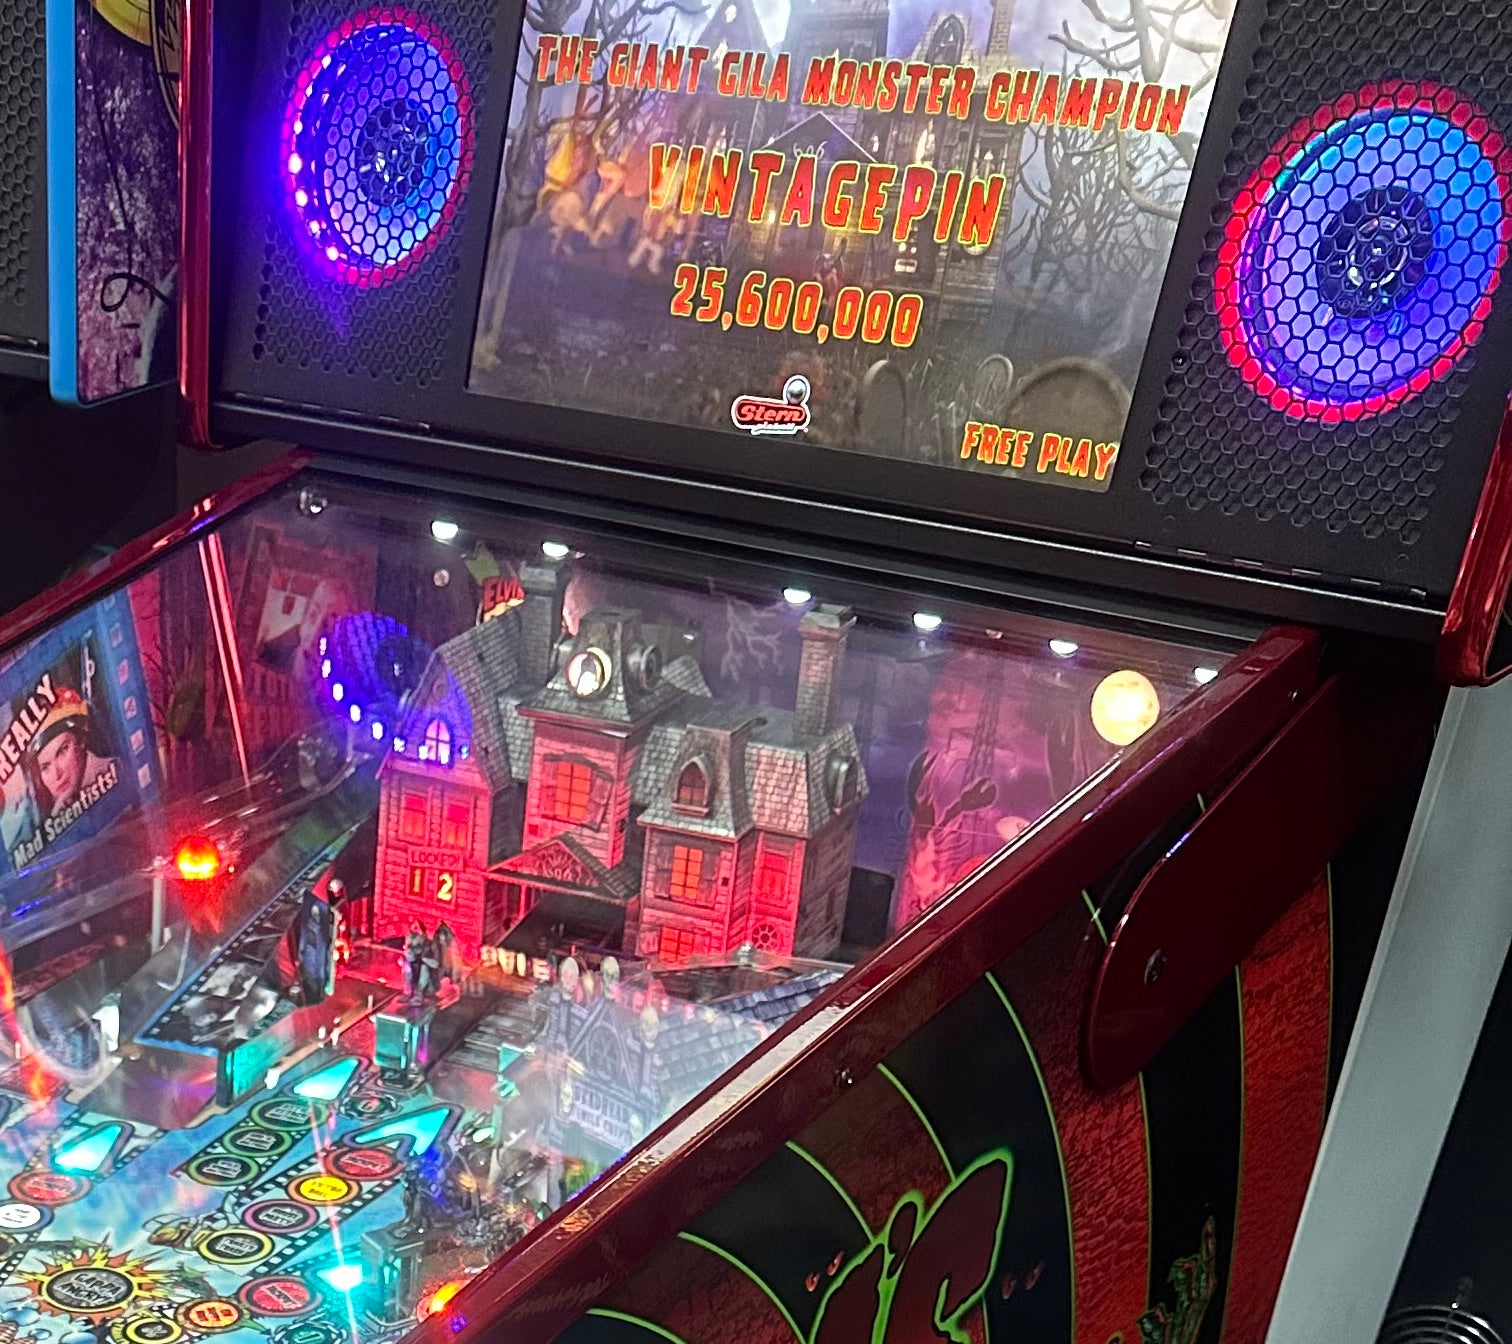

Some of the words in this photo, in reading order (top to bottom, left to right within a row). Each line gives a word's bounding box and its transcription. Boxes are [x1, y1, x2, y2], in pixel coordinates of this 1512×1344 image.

[537, 35, 600, 84] THE
[607, 42, 707, 94] GIANT
[717, 50, 788, 102] GILA
[803, 57, 973, 120] MONSTER
[985, 70, 1191, 137] CHAMPION
[649, 144, 1006, 248] VINTAGEPIN
[670, 264, 924, 348] 25,600,000
[740, 405, 801, 422] Stern
[961, 422, 1034, 467] FREE
[1037, 435, 1119, 482] PLAY
[12, 830, 46, 868] Mad
[44, 762, 121, 845] Scientists!
[437, 873, 453, 901] 2
